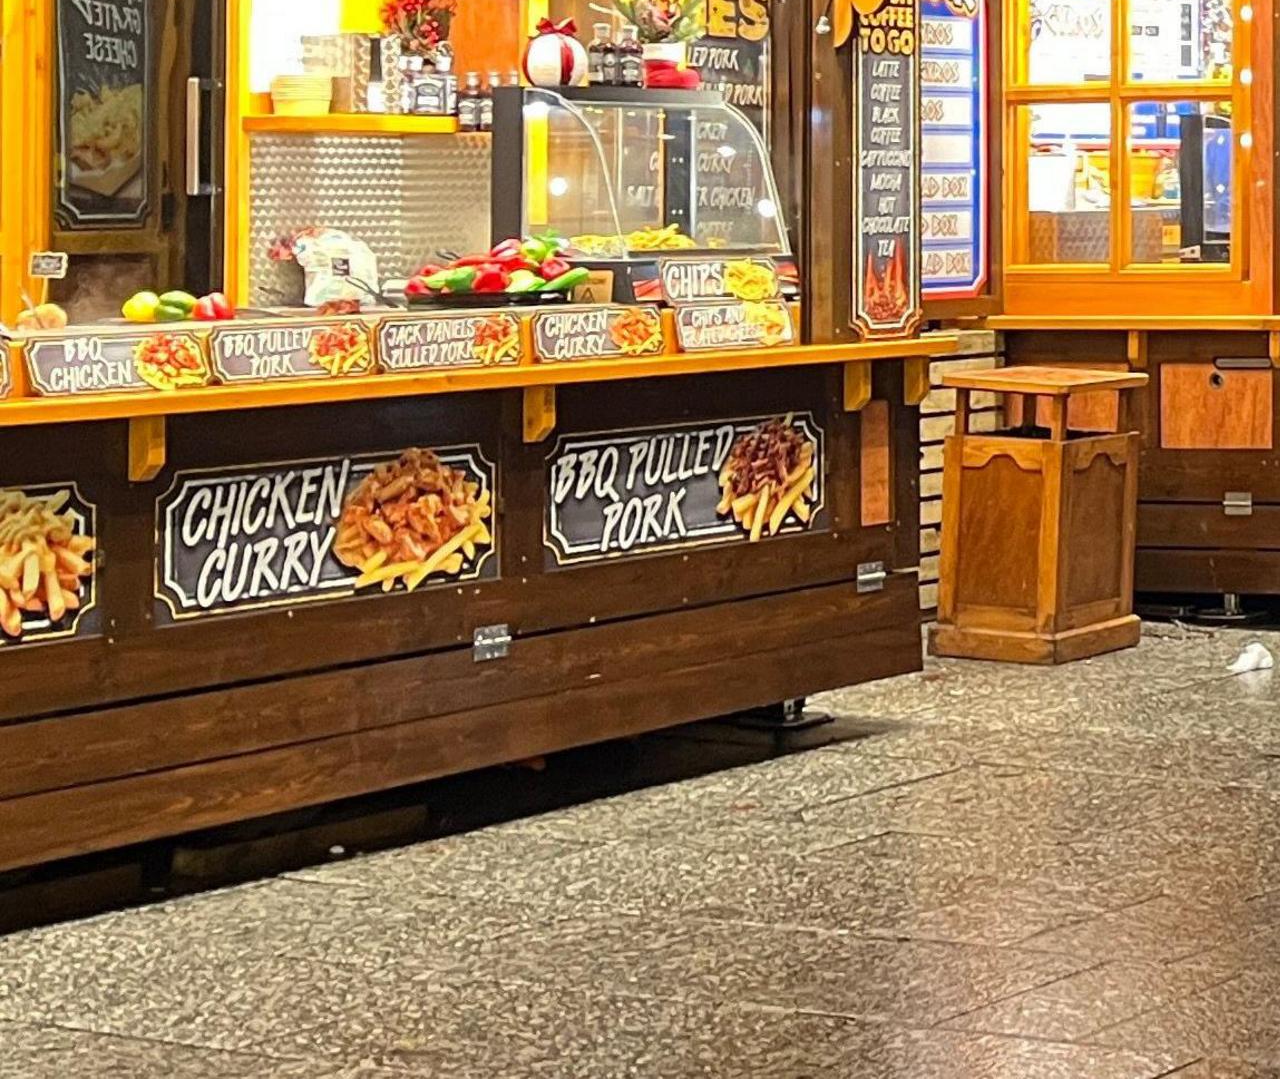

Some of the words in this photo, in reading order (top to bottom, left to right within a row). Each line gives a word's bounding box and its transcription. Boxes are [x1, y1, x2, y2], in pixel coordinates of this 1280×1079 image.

[860, 27, 886, 54] TO
[887, 28, 914, 55] GO
[708, 47, 739, 72] PORK
[872, 61, 900, 78] LATTE
[871, 83, 902, 102] COFFEE
[870, 127, 902, 145] COFFEE
[869, 173, 903, 192] MOCHA
[877, 239, 897, 258] TEA
[665, 263, 723, 302] CHIPS
[387, 321, 424, 345] JACK
[425, 316, 477, 343] DANIELS
[544, 308, 609, 339] CHICKEN
[63, 336, 102, 363] BBQ
[222, 330, 256, 361] BBQ
[258, 325, 312, 354] PULLED
[390, 344, 441, 368] PULLED
[441, 340, 477, 364] PORK
[554, 333, 606, 361] CURRY
[48, 360, 132, 393] CHICKEN
[249, 353, 296, 377] PORK
[554, 445, 621, 504] BBQ
[625, 424, 735, 491] PULLED
[181, 458, 352, 549] CHICKEN
[600, 486, 688, 553] PORK
[196, 526, 337, 609] CURRY
